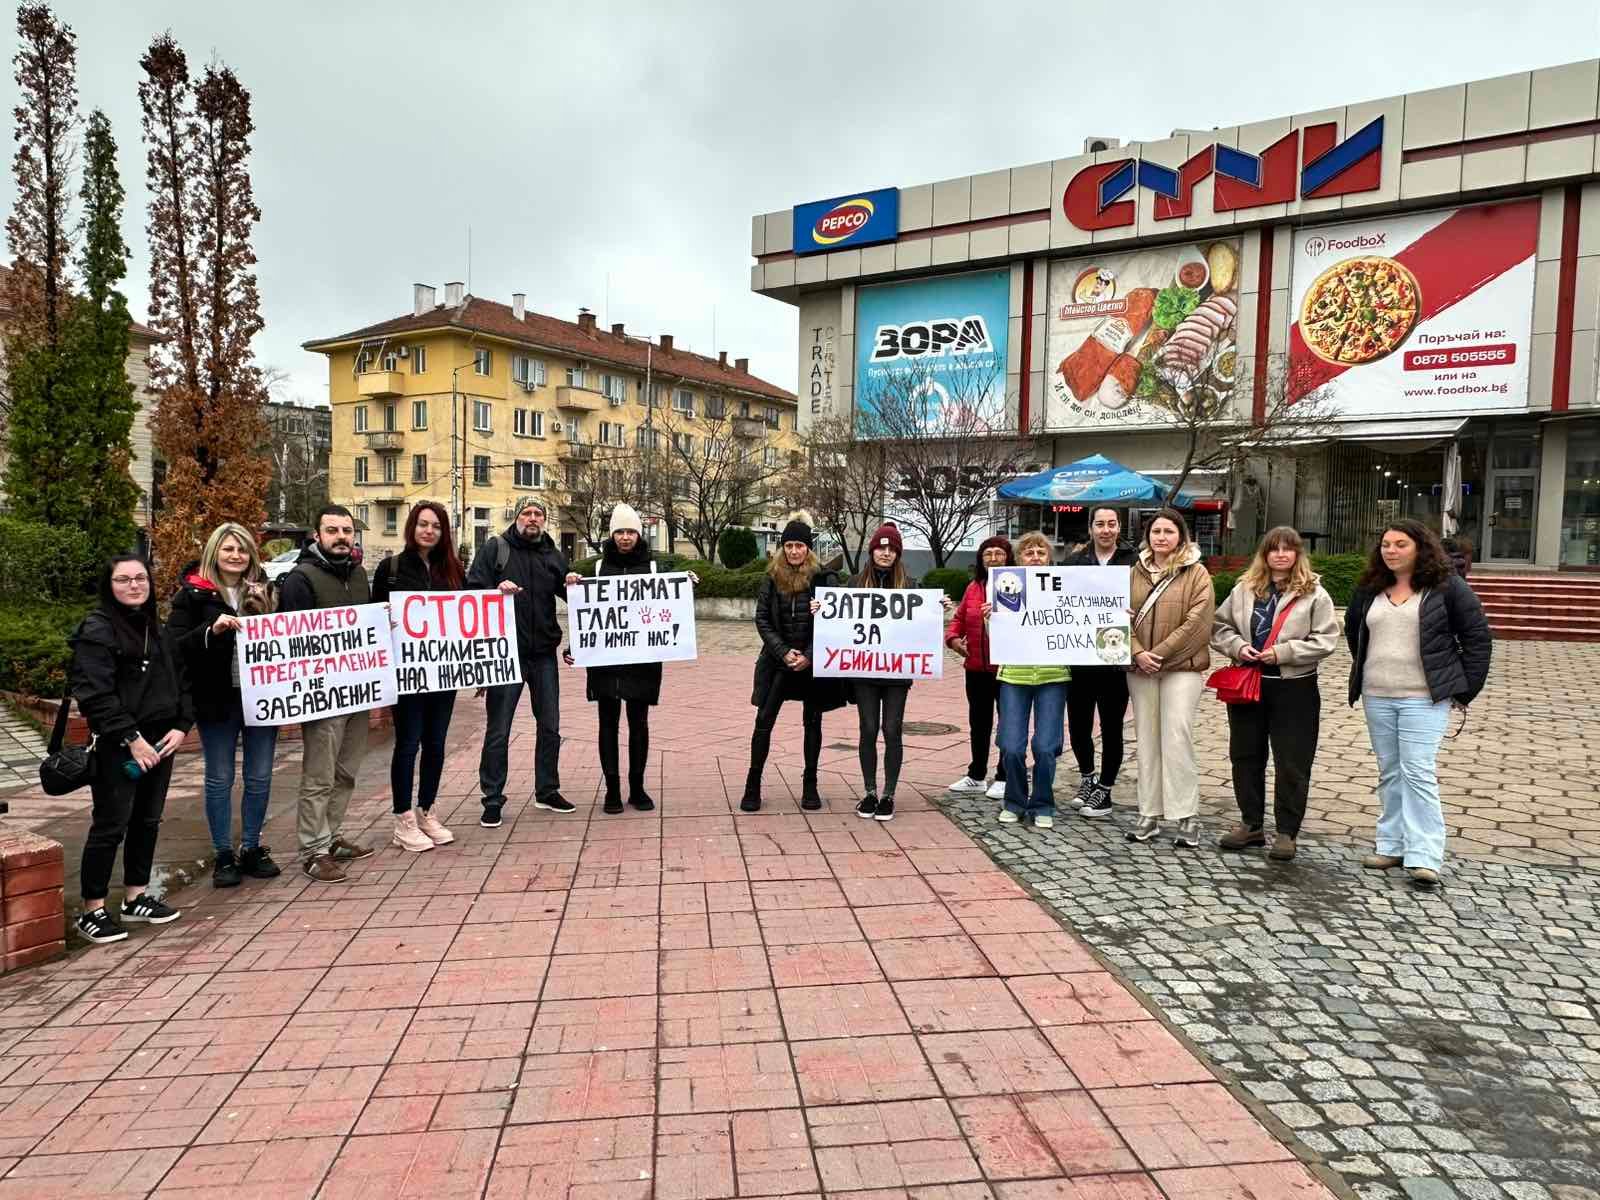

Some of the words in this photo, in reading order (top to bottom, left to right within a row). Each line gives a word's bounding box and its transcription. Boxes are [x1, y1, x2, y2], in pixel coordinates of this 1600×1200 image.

[821, 212, 864, 232] PEPCO
[875, 319, 988, 358] ЗОРА
[1418, 330, 1481, 347] Поръчай
[1484, 329, 1506, 342] на:
[1412, 352, 1447, 366] 0878
[1451, 348, 1506, 364] 505555
[811, 327, 823, 414] TRADE
[1434, 373, 1458, 382] или
[1461, 372, 1477, 381] на
[1403, 383, 1508, 397] www.foodbox.bg
[580, 578, 610, 603] ТЕ
[617, 577, 688, 602] НЯМАТ
[1056, 596, 1125, 609] ЗАСЛУЖАВАТ
[403, 594, 506, 638] СТОП
[822, 591, 924, 620] ЗАТВОР
[246, 608, 357, 640] НАСИЛИЕТО
[577, 606, 629, 631] ГЛАС
[1083, 614, 1092, 625] А
[1098, 612, 1114, 625] НЕ
[245, 640, 285, 664] НАД
[289, 629, 363, 658] ЖИВОТНИ
[367, 627, 376, 646] Е
[579, 631, 597, 649] НО
[604, 630, 640, 649] ИМАТ
[647, 624, 680, 648] НАС!
[853, 623, 882, 645] ЗА
[1046, 633, 1096, 651] БОЛКА
[402, 637, 509, 664] НАСИЛИЕТО
[823, 647, 933, 675] УБИЙЦИТЕ
[250, 649, 388, 685] ПРЕСТЪПЛЕНИЕ
[397, 667, 428, 693] НАД
[438, 658, 515, 689] ЖИВОТНИ
[292, 680, 302, 693] А
[309, 677, 325, 690] НЕ
[256, 681, 382, 721] ЗАБАВЛЕНИЕ
